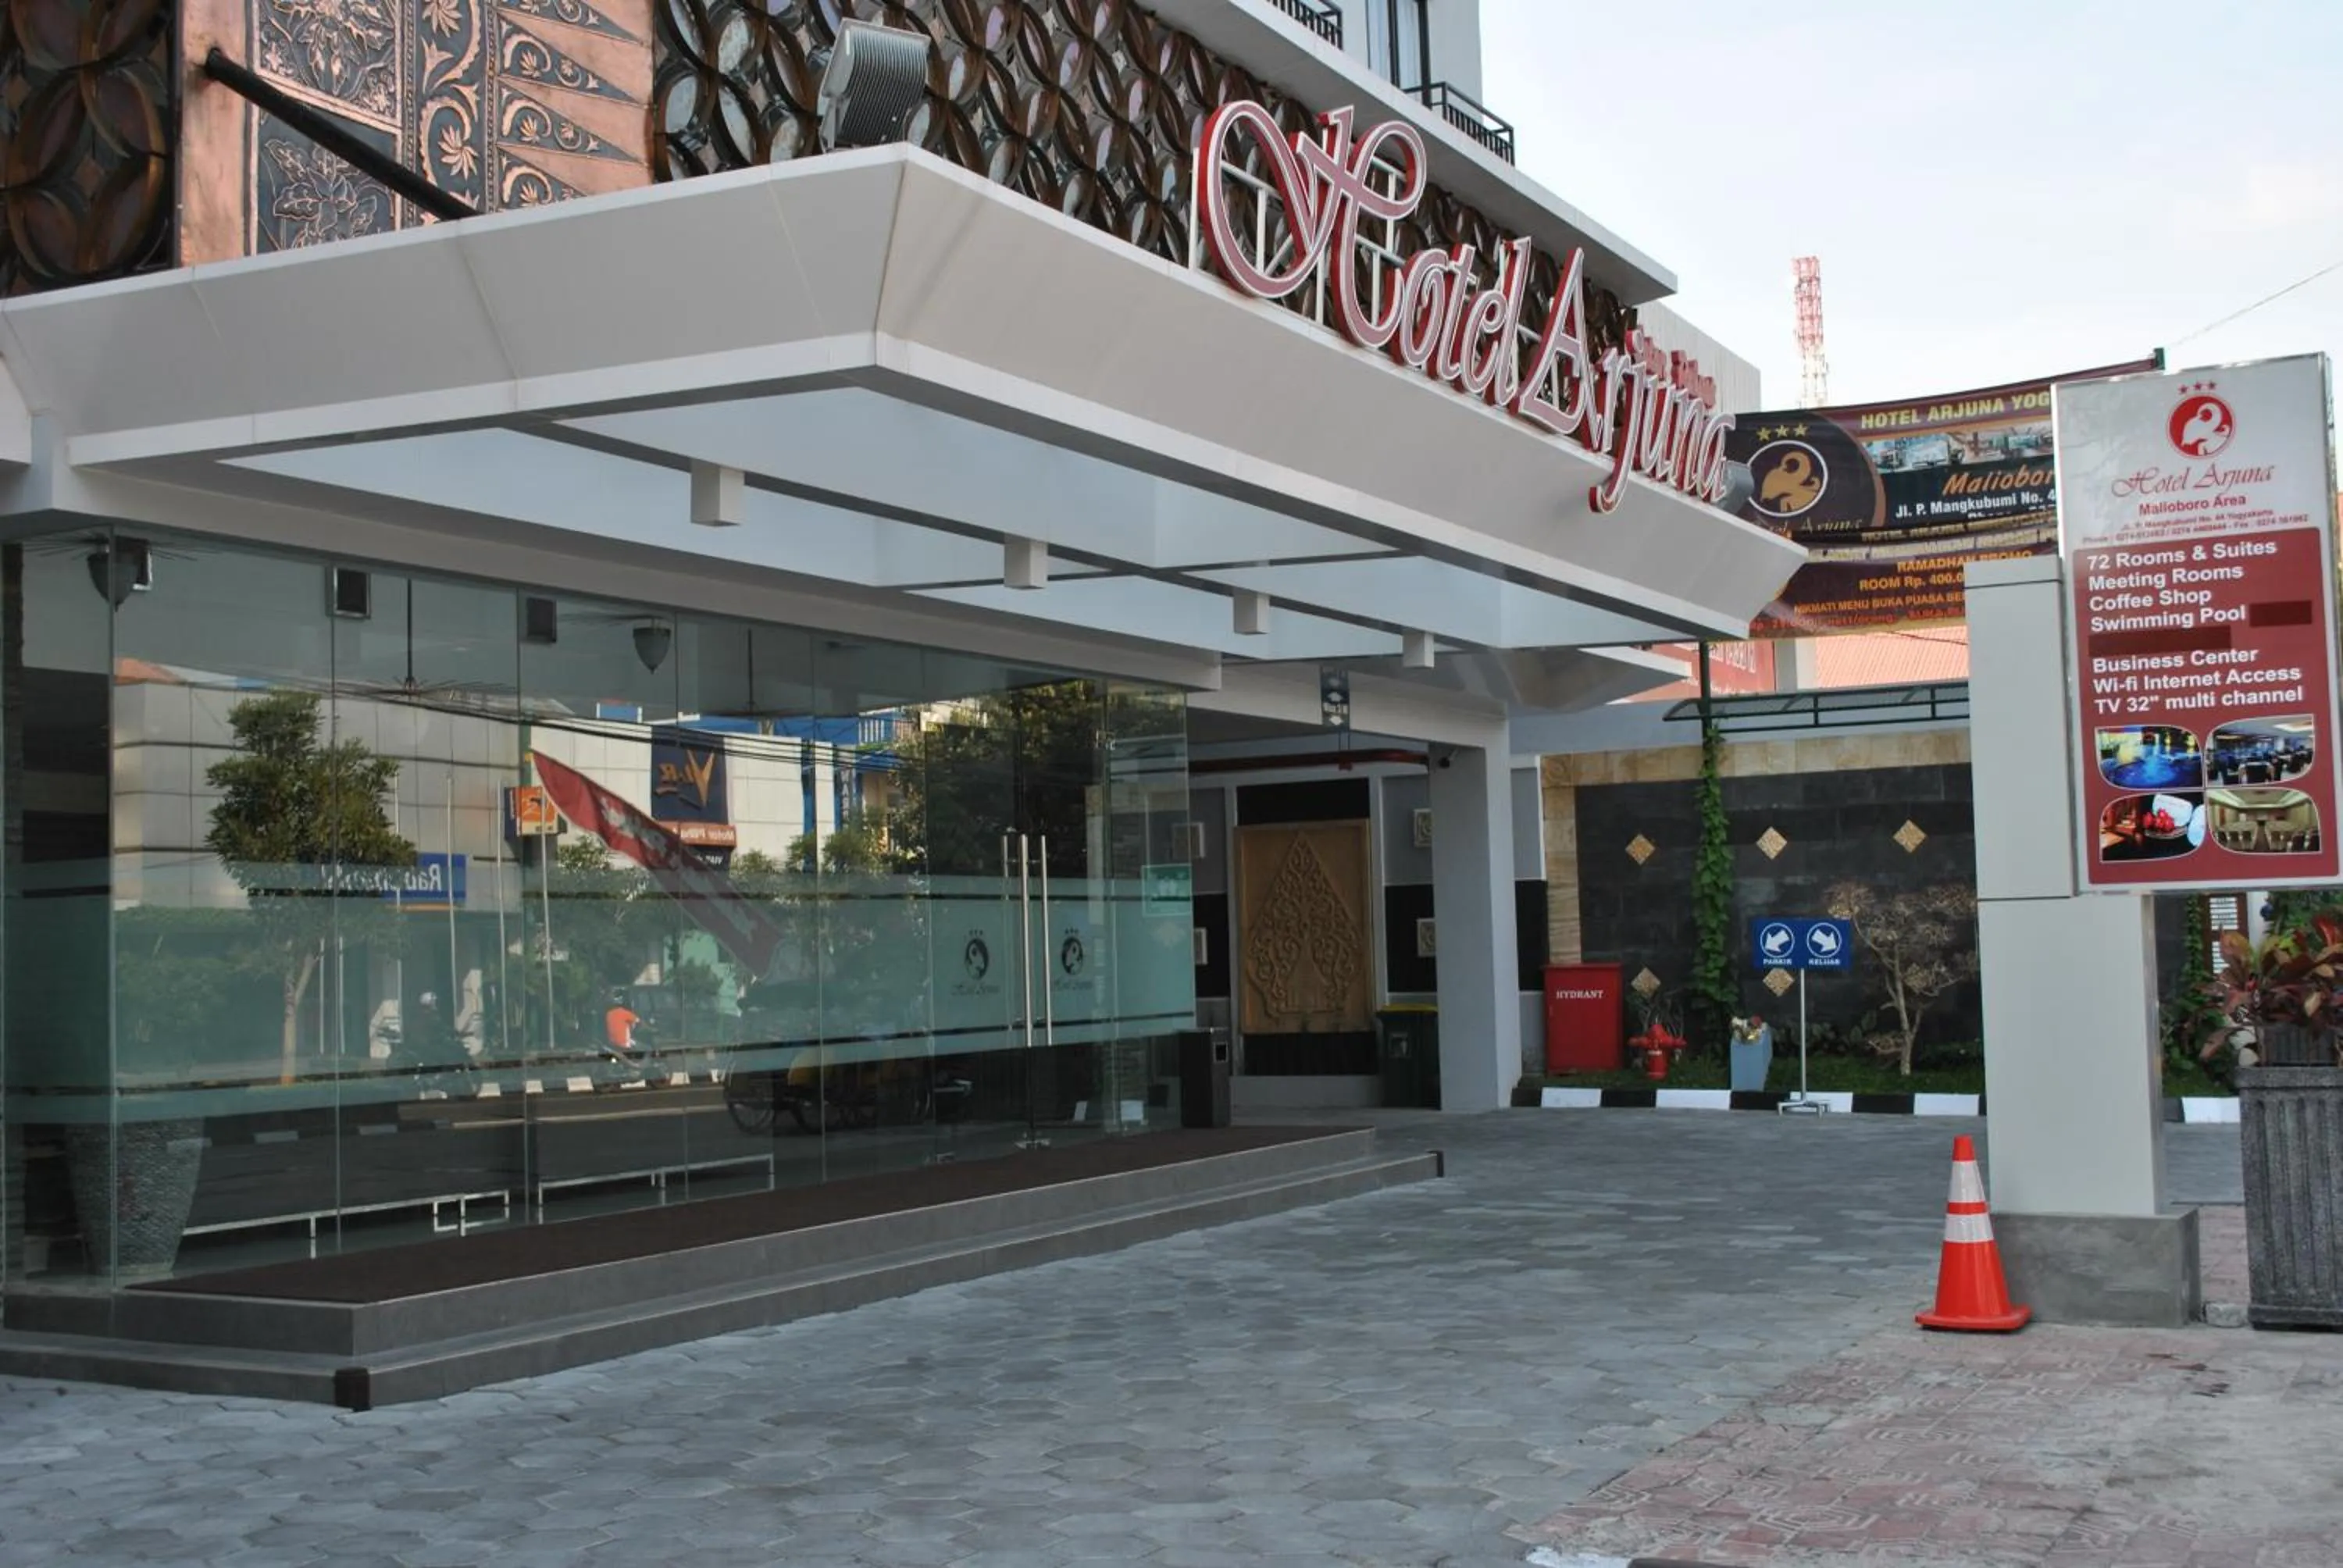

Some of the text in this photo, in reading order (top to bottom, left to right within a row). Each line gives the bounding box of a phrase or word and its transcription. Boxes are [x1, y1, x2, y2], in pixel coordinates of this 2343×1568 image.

[1199, 99, 1736, 514] Hotel Arjuna
[1861, 409, 1921, 429] HOTEL
[1928, 397, 2005, 422] ARJUNA
[2111, 462, 2274, 497] Hotel Arjuna
[1916, 503, 1928, 516] P.
[1931, 494, 2017, 513] Mangkubumi
[2021, 490, 2043, 504] No.
[2138, 494, 2247, 516] Malioboro Area
[2087, 540, 2277, 572] 72 Rooms & Suites
[1860, 577, 1900, 591] ROOM
[1904, 576, 1926, 589] Rp.
[2088, 565, 2244, 591] Meeting Rooms
[1838, 598, 1870, 610] MENU
[1872, 596, 1903, 608] BUKA
[1905, 593, 1945, 606] PUASA
[2089, 590, 2212, 611] Coffee Shop
[2091, 605, 2245, 633] Swimming Pool
[2093, 648, 2259, 674] Business Center
[2093, 665, 2302, 694] Wi-fi Internet Access
[2095, 686, 2303, 715] TV 32" multi channel
[1557, 989, 1603, 1000] HYDRANT
